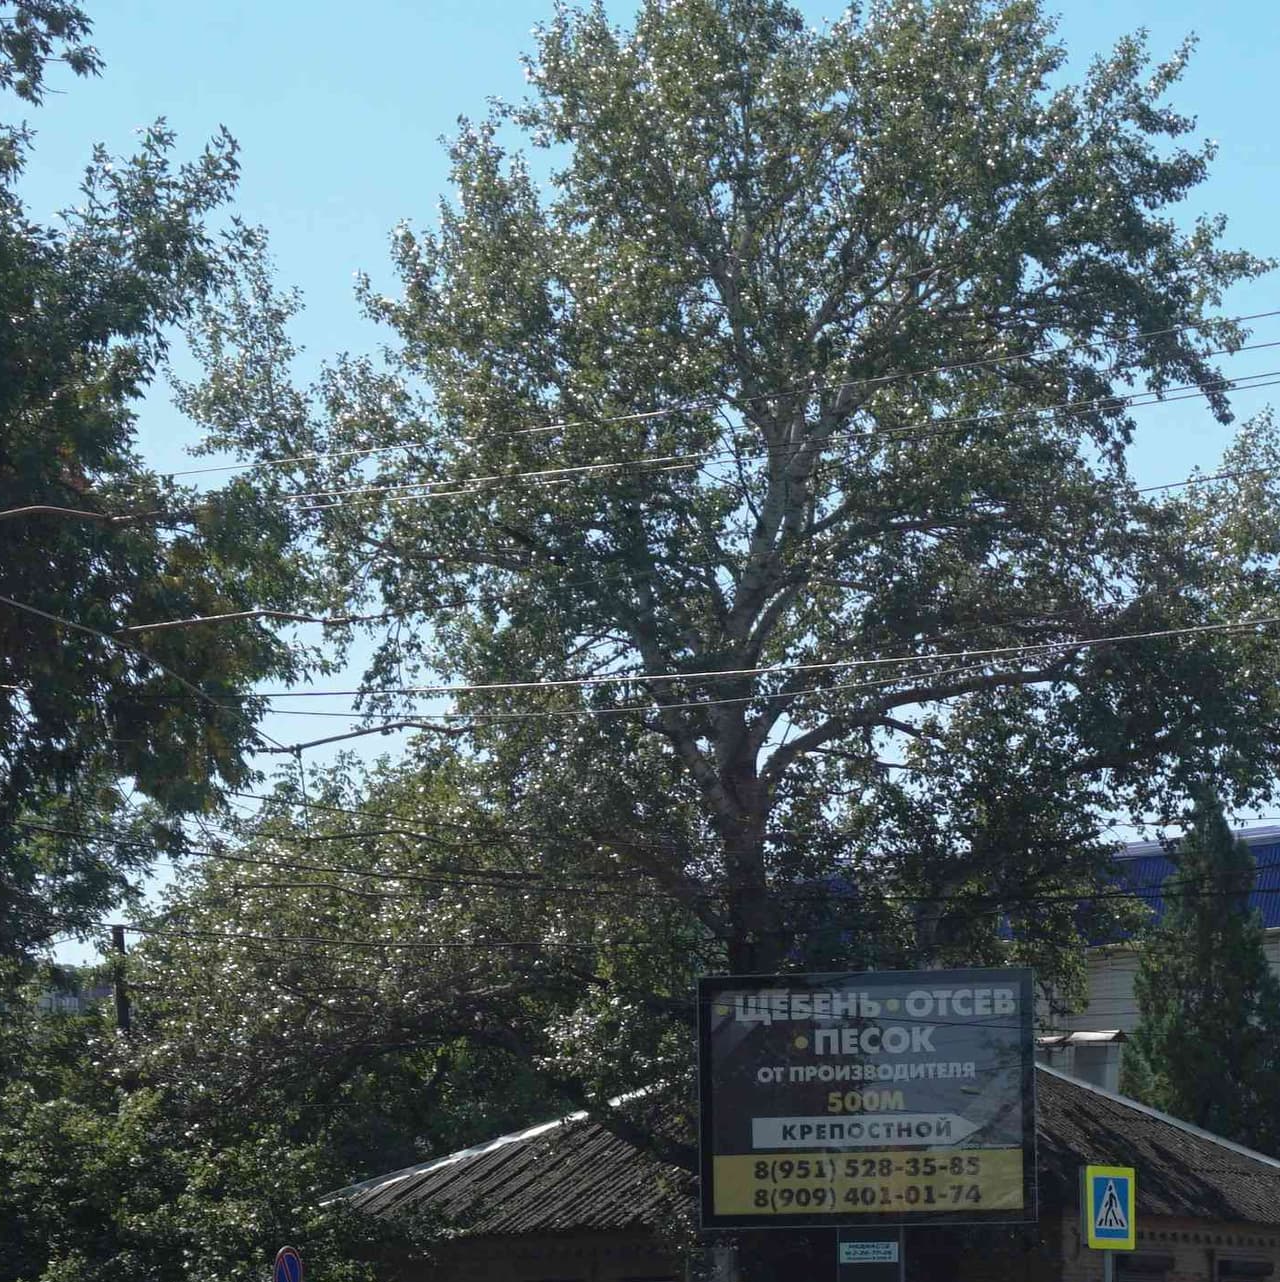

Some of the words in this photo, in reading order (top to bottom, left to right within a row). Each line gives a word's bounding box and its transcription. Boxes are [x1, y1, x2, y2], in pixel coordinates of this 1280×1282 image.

[735, 990, 881, 1025] ЩЕБЕНЬ
[905, 988, 1016, 1018] ОТСЕВ
[814, 1026, 937, 1055] ПЕСОК
[757, 1066, 784, 1083] ОТ
[789, 1062, 976, 1083] ПРОИЗВОДИТЕЛЯ
[827, 1090, 905, 1113] 500М
[782, 1117, 952, 1141] КРЕПОСТНОЙ
[754, 1158, 836, 1183] 8(951)
[844, 1156, 981, 1178] 528-35-85
[754, 1187, 836, 1212] 8(909)
[844, 1184, 982, 1205] 401-01-74
